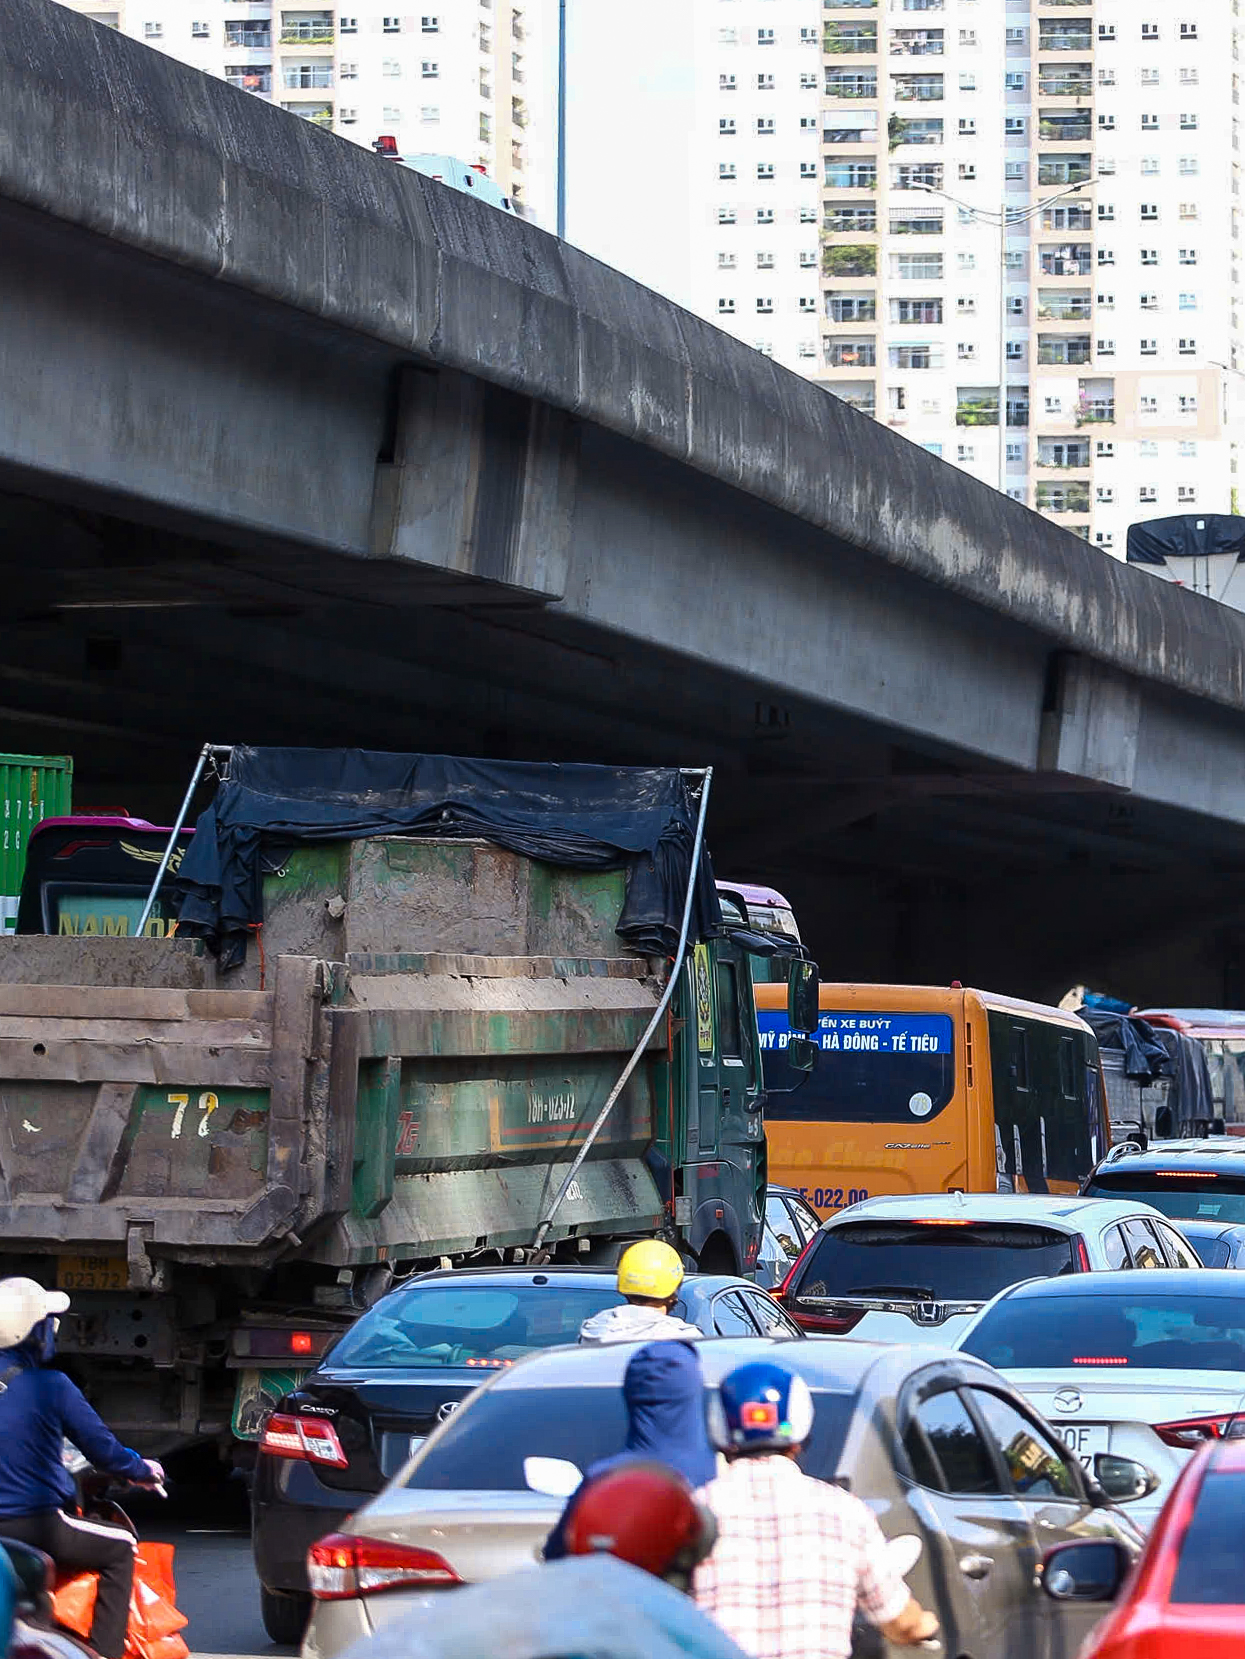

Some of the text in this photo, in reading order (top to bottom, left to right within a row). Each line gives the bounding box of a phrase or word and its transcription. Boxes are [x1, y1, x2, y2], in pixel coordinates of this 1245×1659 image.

[840, 1019, 856, 1028] XE
[859, 1018, 892, 1029] BUÝT
[823, 1032, 840, 1049] HÀ
[843, 1033, 879, 1050] ĐÔNG
[892, 1031, 907, 1051] TẾ
[910, 1034, 938, 1052] TIÊU
